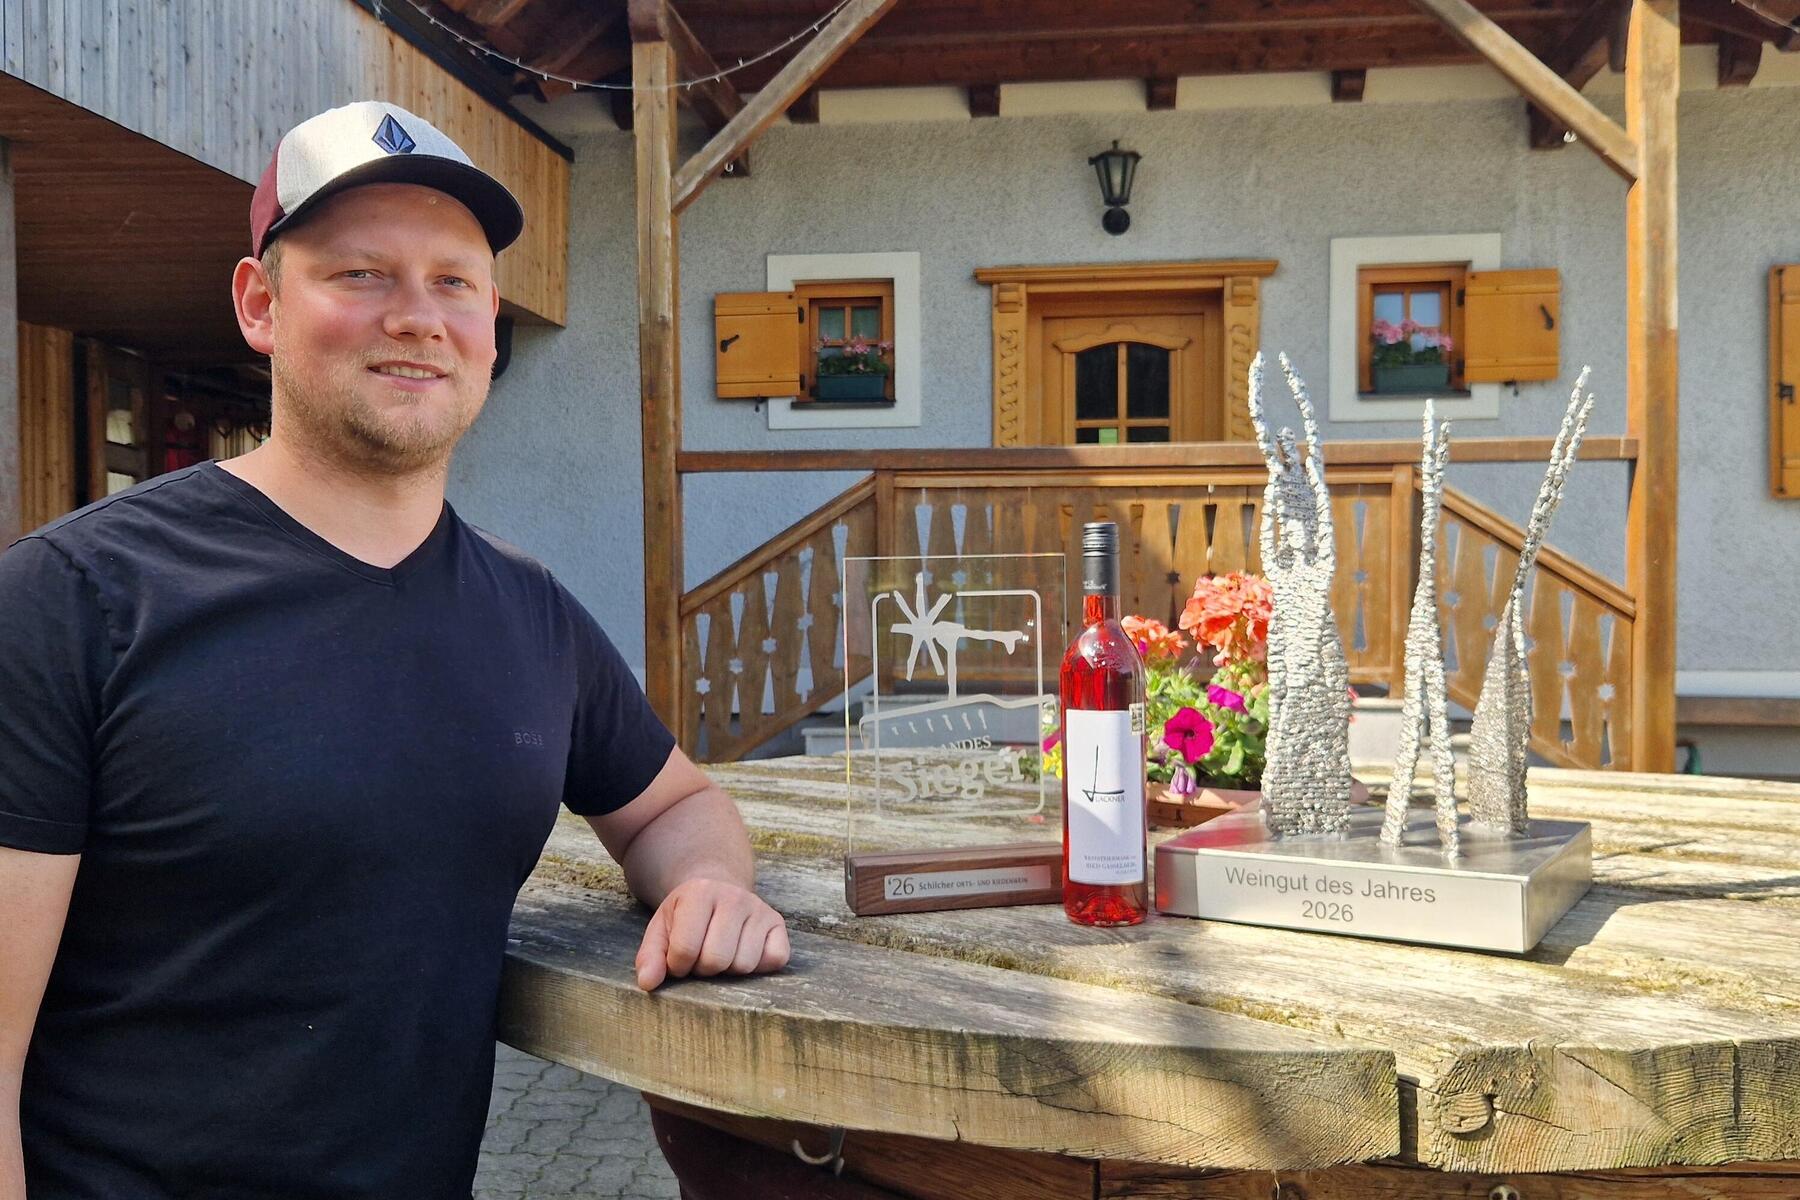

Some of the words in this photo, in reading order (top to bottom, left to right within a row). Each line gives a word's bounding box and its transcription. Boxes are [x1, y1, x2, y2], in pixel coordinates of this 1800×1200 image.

[931, 735, 992, 756] ANDES
[892, 747, 1027, 802] Sieger
[919, 880, 954, 890] Schilcher
[977, 879, 990, 887] UND
[1225, 866, 1308, 894] Weingut
[1315, 875, 1353, 895] des
[1361, 878, 1436, 903] Jahres
[1301, 899, 1354, 922] 2026
